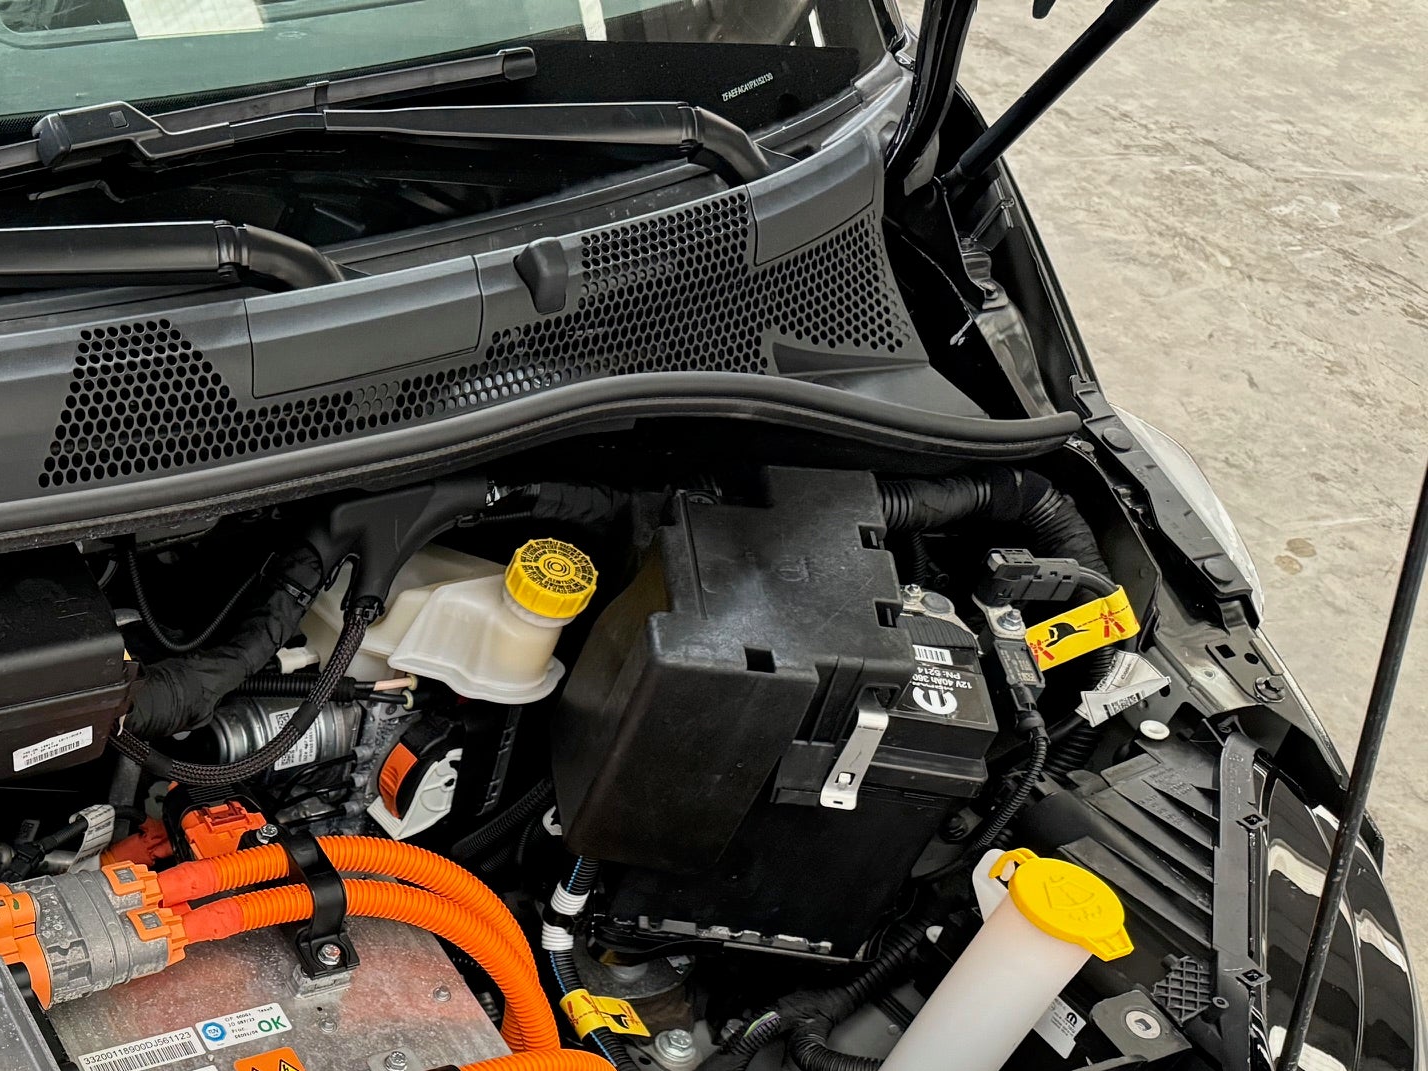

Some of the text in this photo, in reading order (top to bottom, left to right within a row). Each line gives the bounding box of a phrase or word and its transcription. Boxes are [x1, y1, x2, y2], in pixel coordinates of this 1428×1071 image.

[956, 680, 972, 689] 12V
[258, 1016, 287, 1032] OK
[84, 1032, 192, 1064] 33200118900DJ561123
